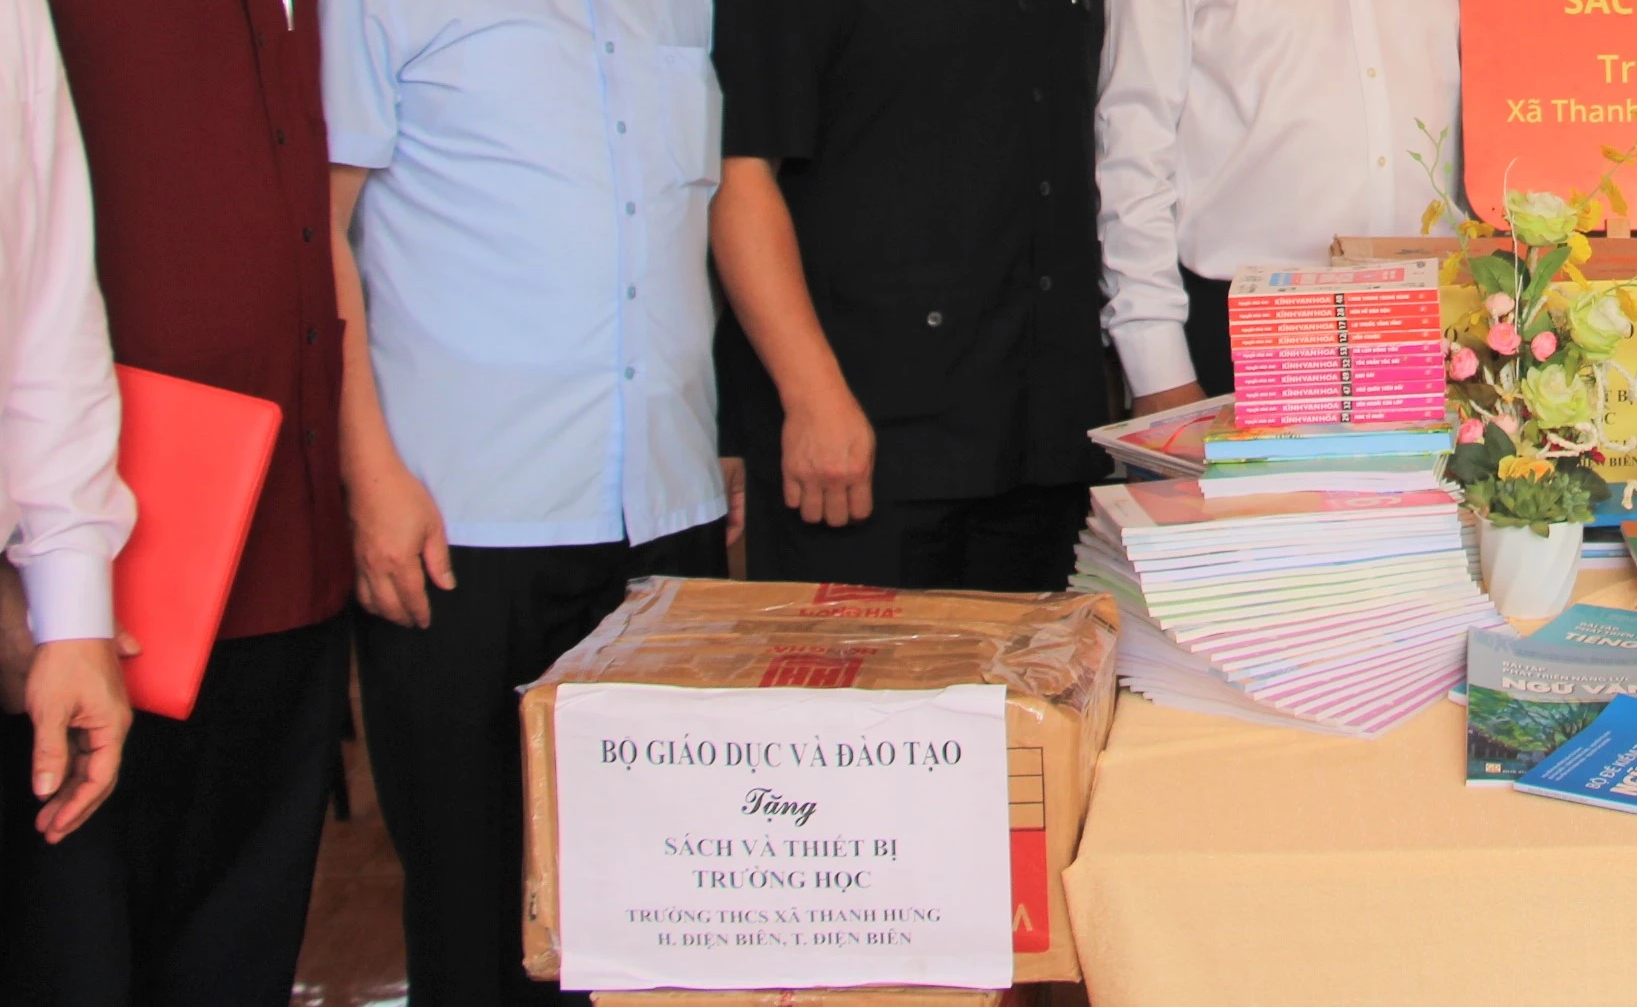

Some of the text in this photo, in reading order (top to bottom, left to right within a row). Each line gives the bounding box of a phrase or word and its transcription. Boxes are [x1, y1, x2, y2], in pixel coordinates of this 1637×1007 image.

[1508, 100, 1541, 123] Xã
[1502, 676, 1575, 694] NGỮ
[602, 733, 963, 774] BỘ GIÁO DỤC VÀ ĐÀO TẠO
[1585, 774, 1604, 790] BỘ
[1602, 765, 1618, 783] ĐỀ
[741, 787, 818, 828] Tặng
[664, 833, 898, 862] SÁCH VÀ THIẾT BỊ
[692, 866, 872, 894] TRƯỜNG HỌC
[626, 906, 942, 924] TRƯỜNG THCS XÃ THANH HƯNG
[658, 930, 912, 949] H. ĐIỆN BIÊN, T. ĐIỆN BIÊN
